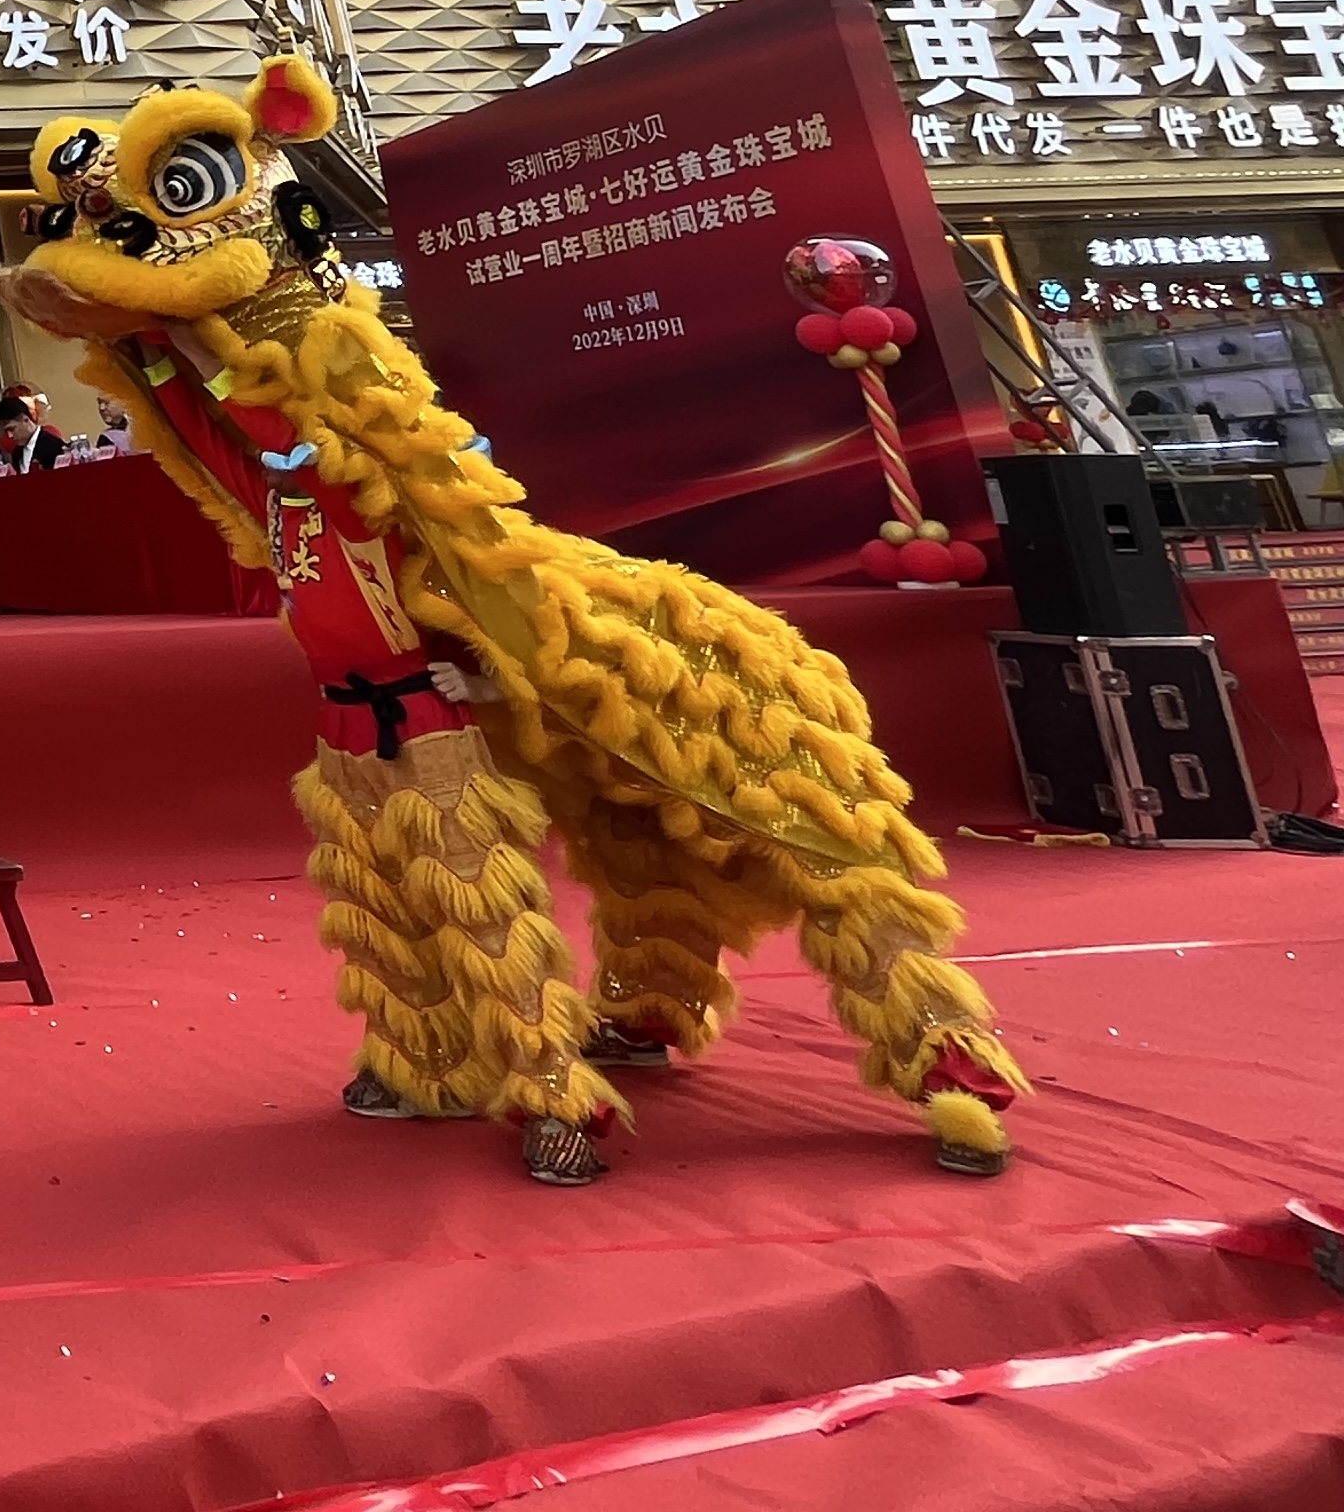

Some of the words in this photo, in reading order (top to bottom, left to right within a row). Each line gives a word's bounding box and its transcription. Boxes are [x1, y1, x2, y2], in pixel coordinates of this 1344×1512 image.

[507, 113, 668, 186] 深圳市罗湖区水贝
[465, 186, 777, 286] 试营业一周年暨招商新闻发布会
[1086, 235, 1272, 267] 老水贝黄金珠宝城
[572, 317, 685, 351] 2022年12月9日
